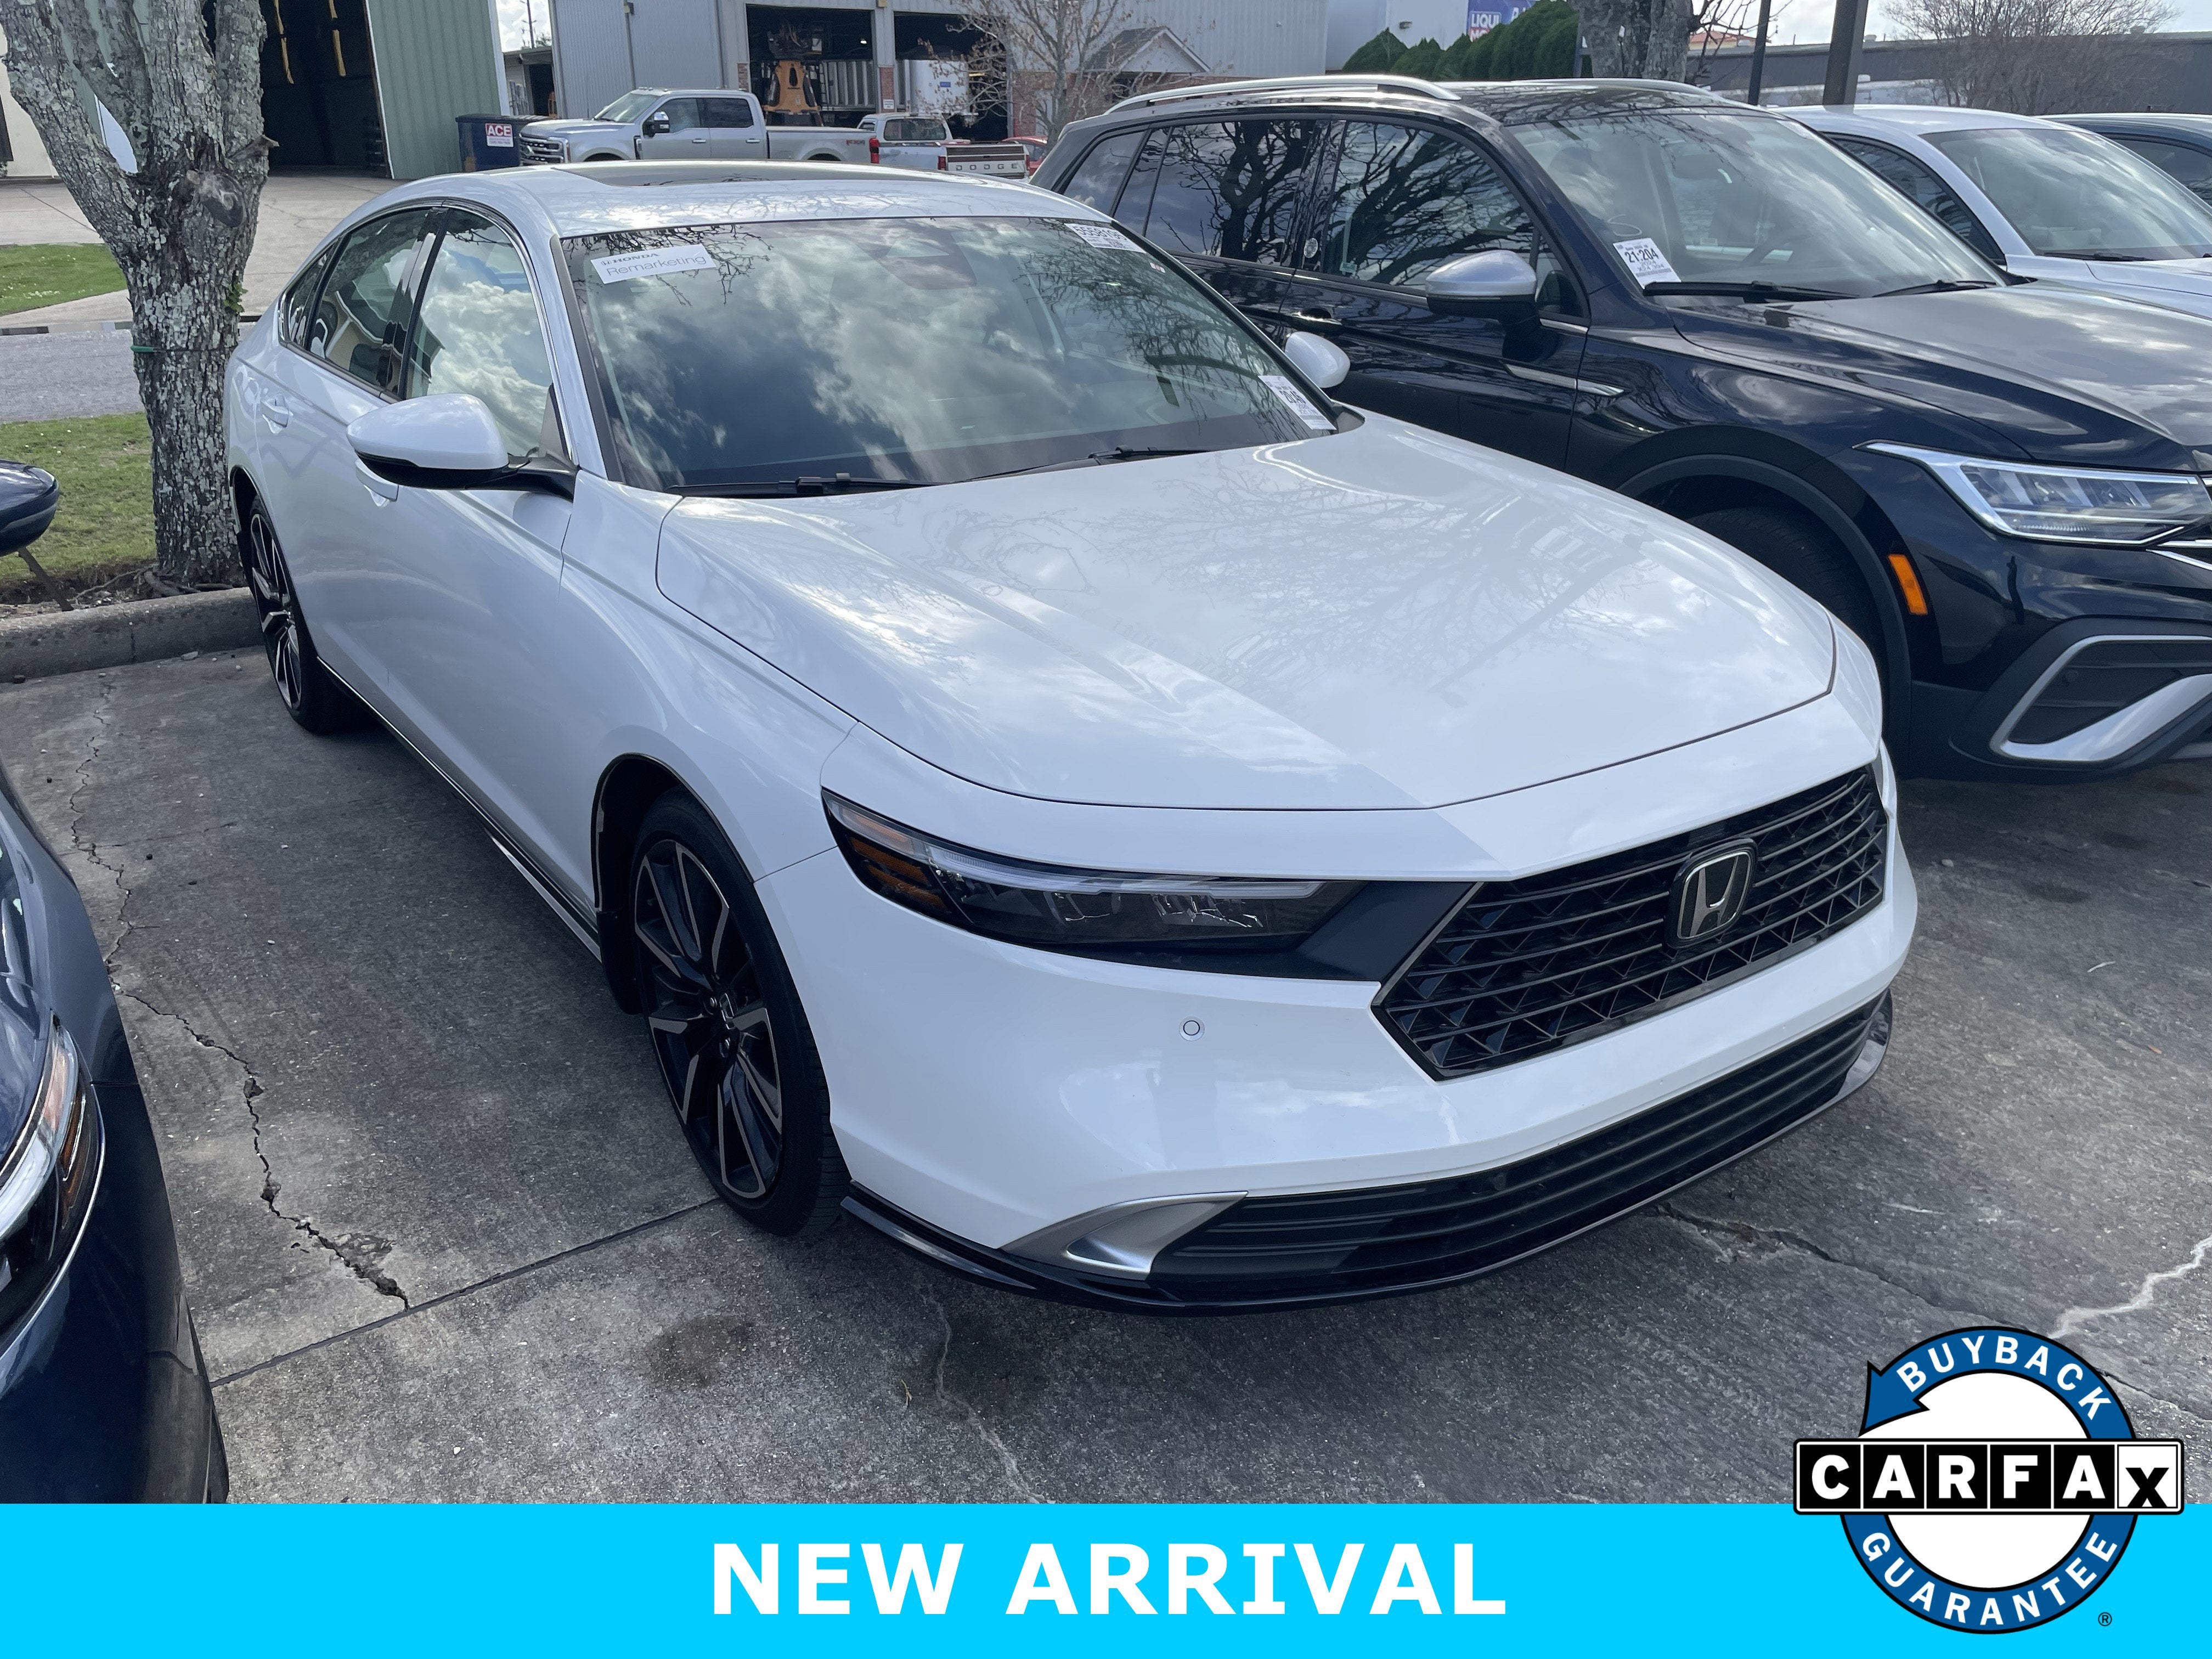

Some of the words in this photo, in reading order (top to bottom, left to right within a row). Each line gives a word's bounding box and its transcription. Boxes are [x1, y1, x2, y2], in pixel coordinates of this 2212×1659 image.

[1471, 14, 1500, 29] LIQUI
[488, 125, 513, 136] ACE
[613, 252, 658, 263] HONDA
[1624, 248, 1659, 263] 21:204
[606, 256, 707, 276] Remarketing
